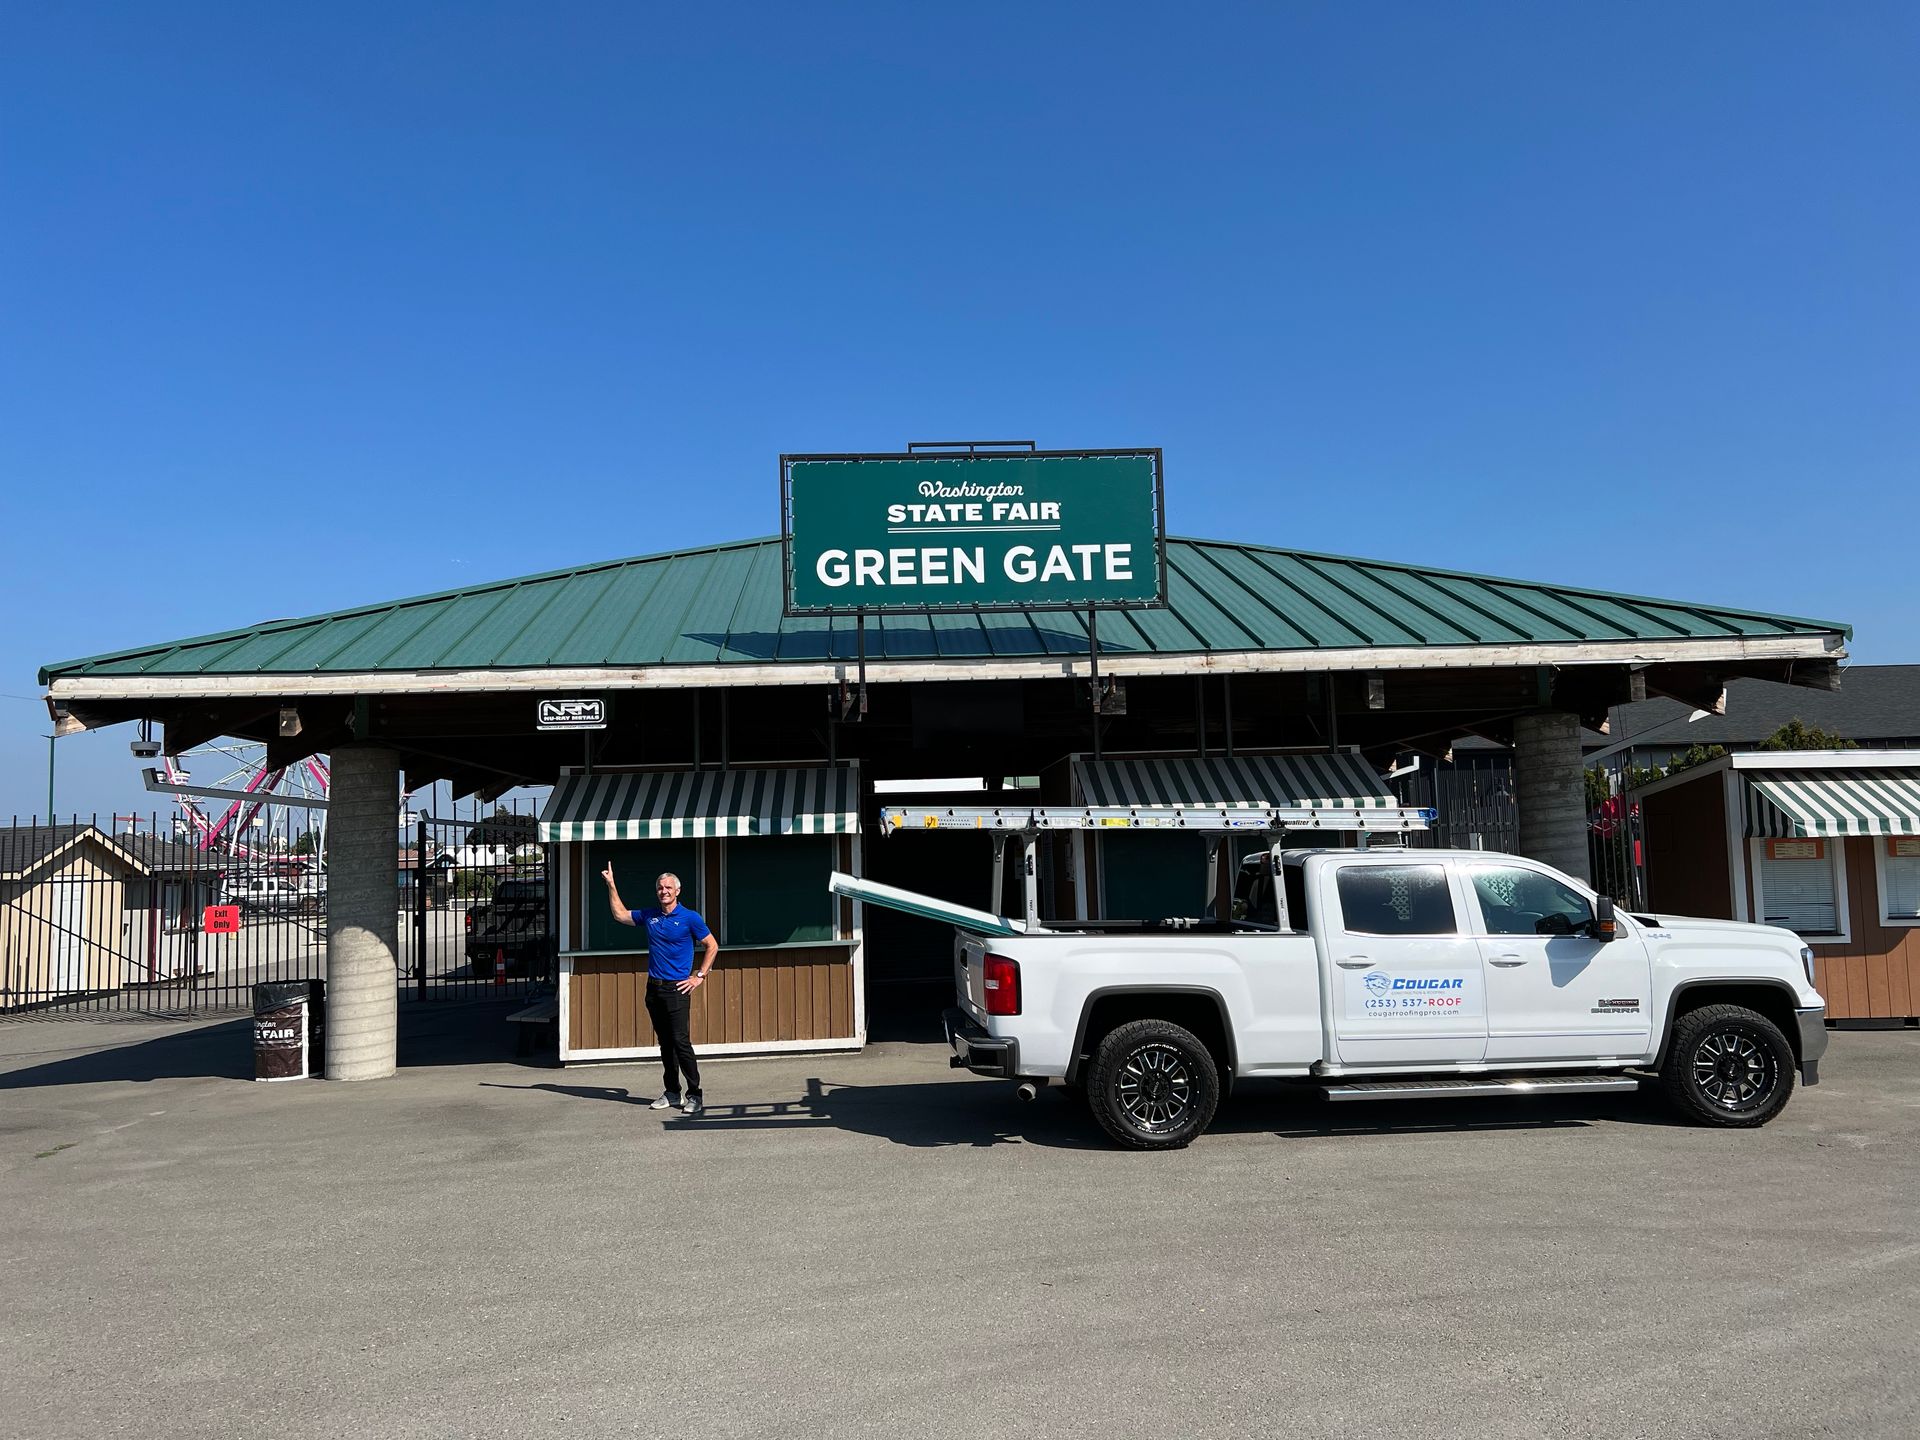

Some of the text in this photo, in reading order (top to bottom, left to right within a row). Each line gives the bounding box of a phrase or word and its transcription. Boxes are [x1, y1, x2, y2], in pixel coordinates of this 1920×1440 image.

[918, 480, 1024, 502] Washington
[887, 502, 1061, 523] STATE FAIR
[816, 543, 1133, 587] GREEN GATE
[543, 702, 600, 716] NRM
[214, 910, 228, 918] Exit
[213, 920, 230, 929] Only
[1392, 978, 1464, 990] COUGAR
[1365, 997, 1462, 1008] (253) 537-ROOF
[262, 1028, 295, 1039] FAIR
